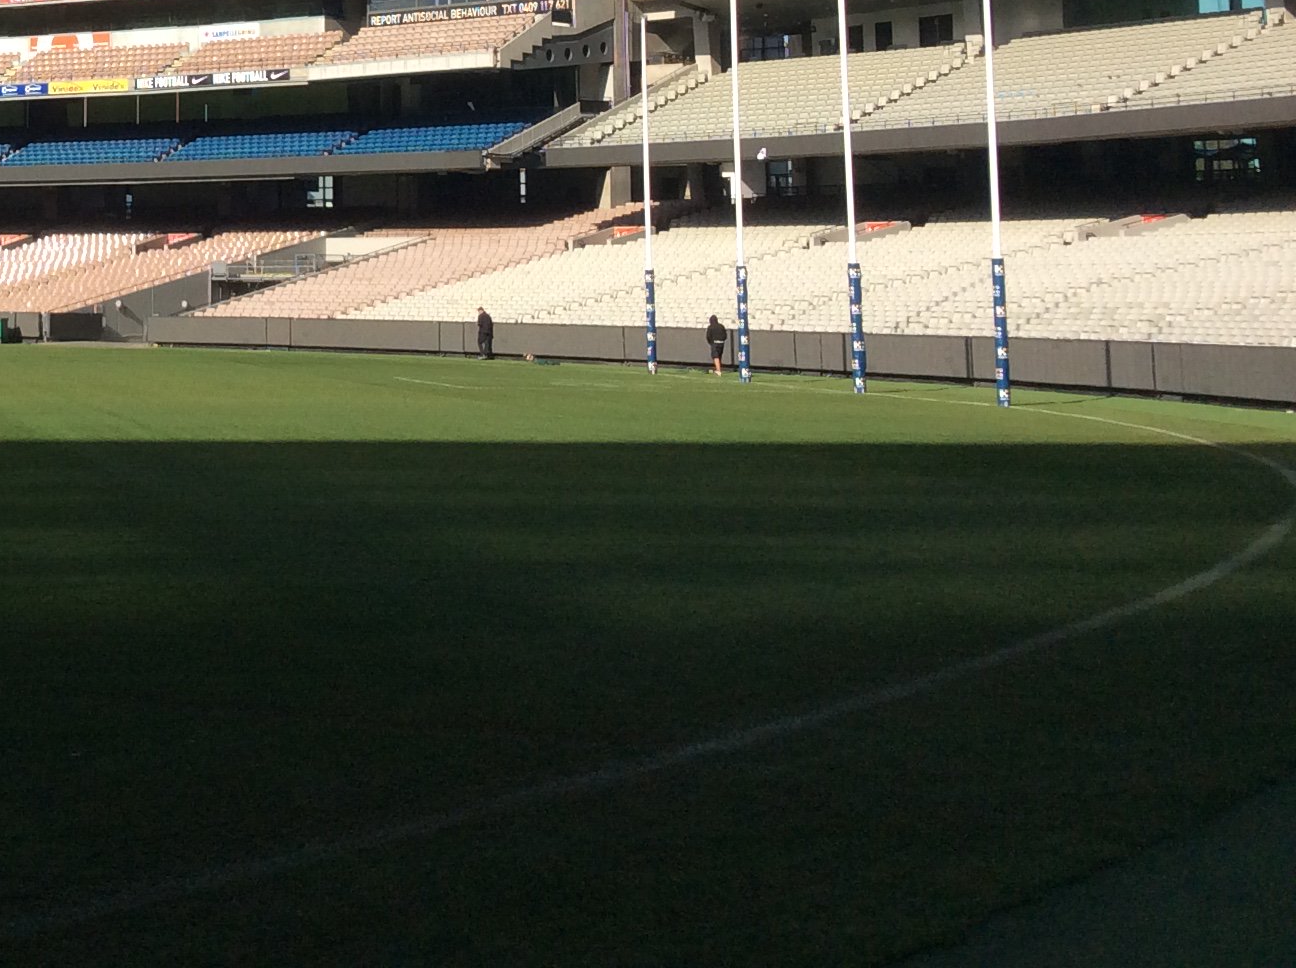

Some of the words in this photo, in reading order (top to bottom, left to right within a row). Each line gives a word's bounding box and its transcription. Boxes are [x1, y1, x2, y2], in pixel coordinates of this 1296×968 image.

[370, 13, 401, 26] REPORT
[402, 10, 449, 23] ANTISOCIAL
[450, 5, 497, 19] BEHAVIOUR
[502, 3, 518, 15] TXT
